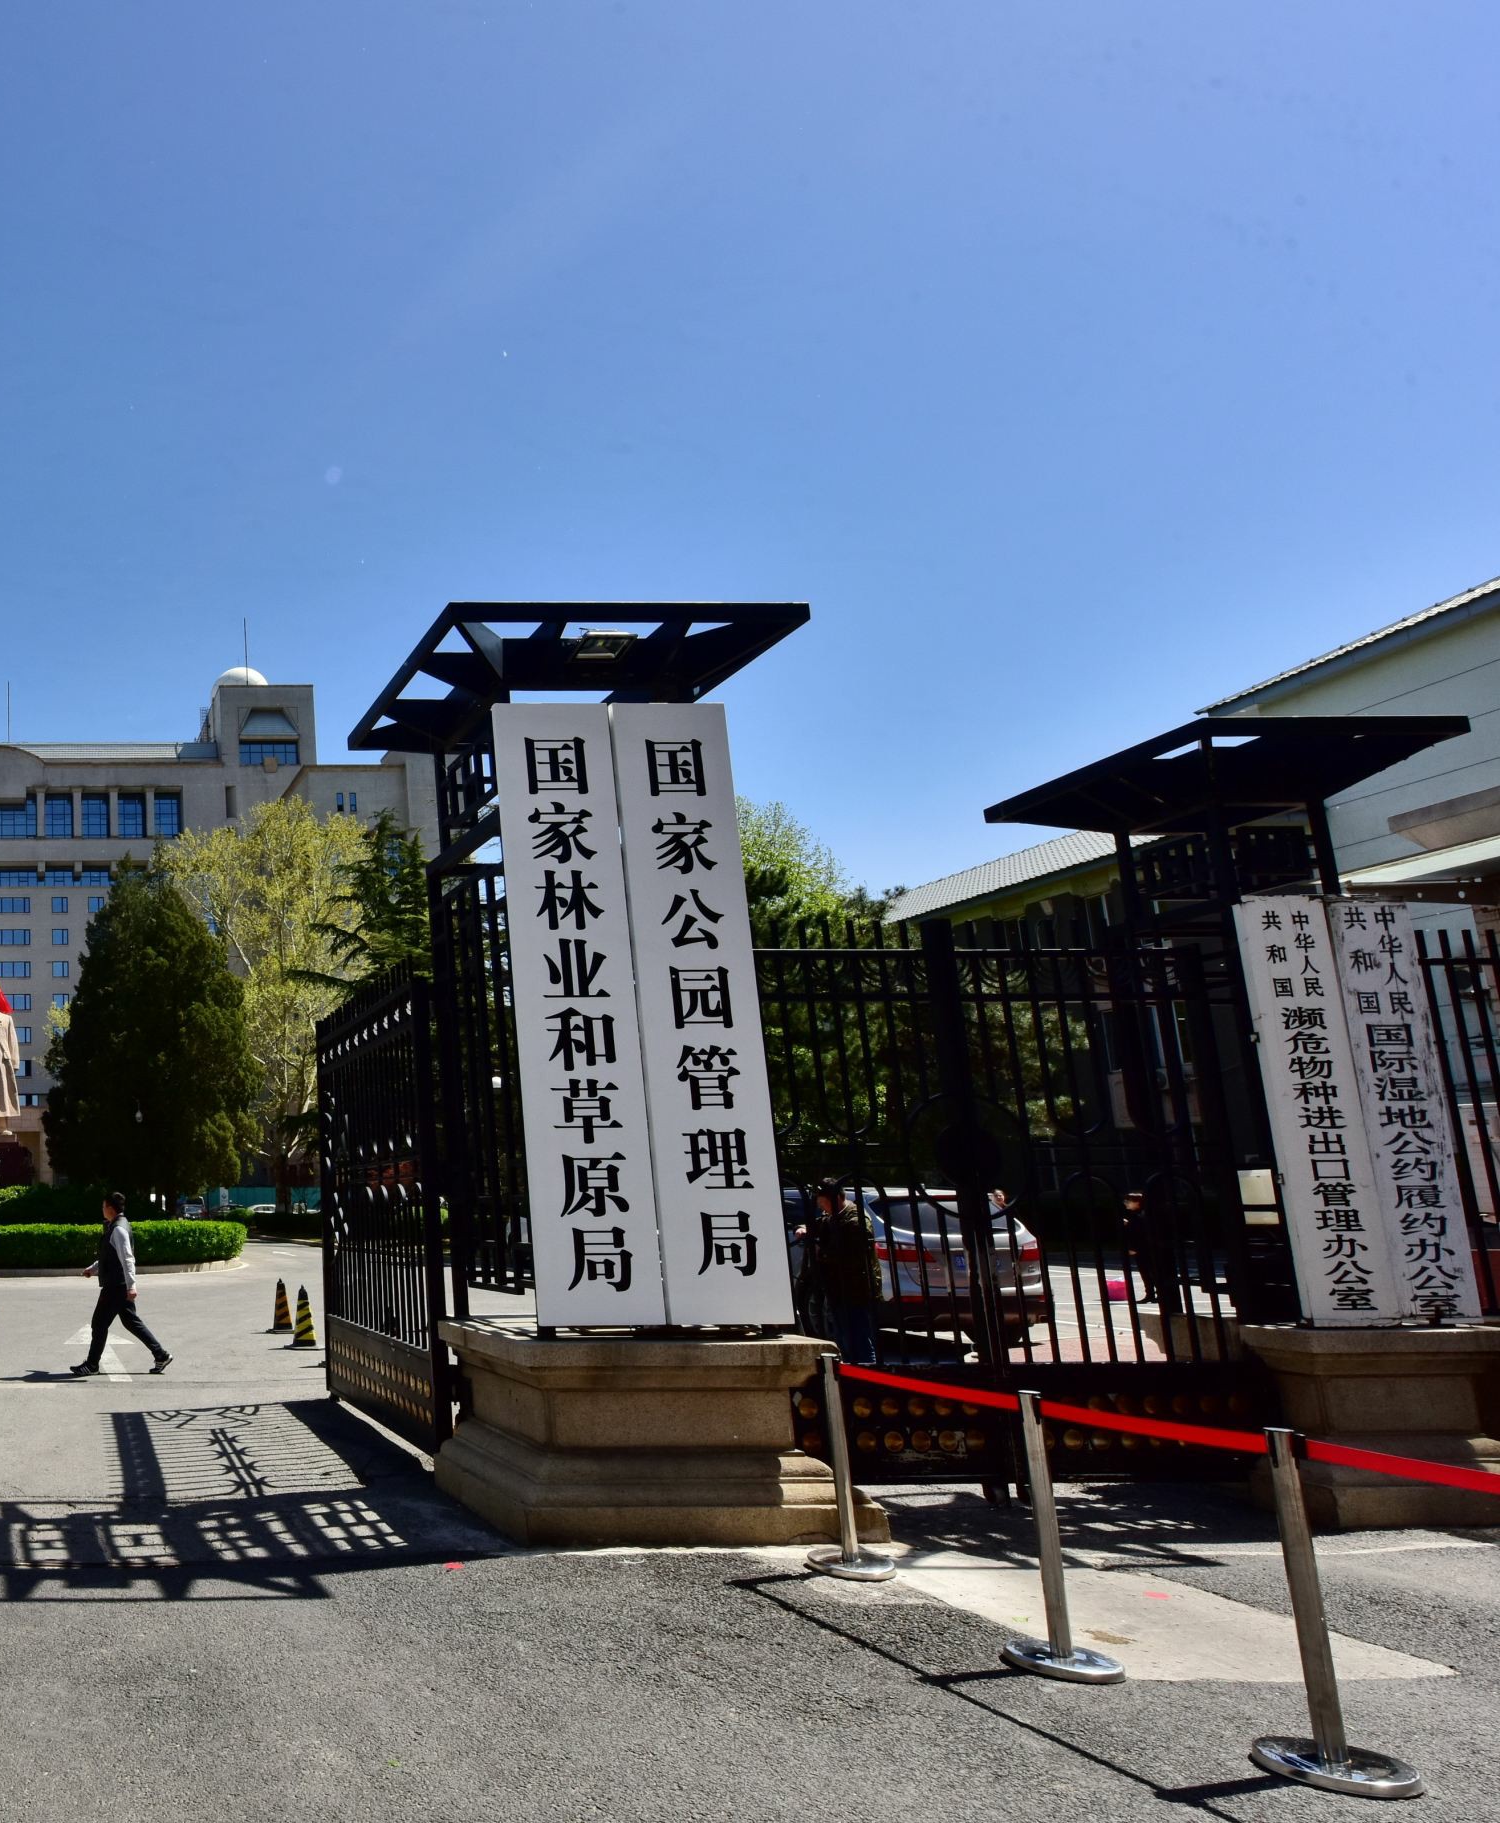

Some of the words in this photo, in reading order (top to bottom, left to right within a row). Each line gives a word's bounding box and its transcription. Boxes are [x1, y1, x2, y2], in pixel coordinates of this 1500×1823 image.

[523, 736, 634, 1293] 国家林业和草原局
[644, 737, 758, 1278] 国家公园管理局
[1262, 910, 1294, 998] 共和国
[1291, 910, 1325, 998] 中华人民
[1344, 905, 1381, 1015] 共和国
[1373, 905, 1414, 1015] 中华人民
[1281, 1006, 1378, 1312] 濒危物种进出口管理办公室
[1365, 1022, 1465, 1317] 国际湿地公约履约办公室
